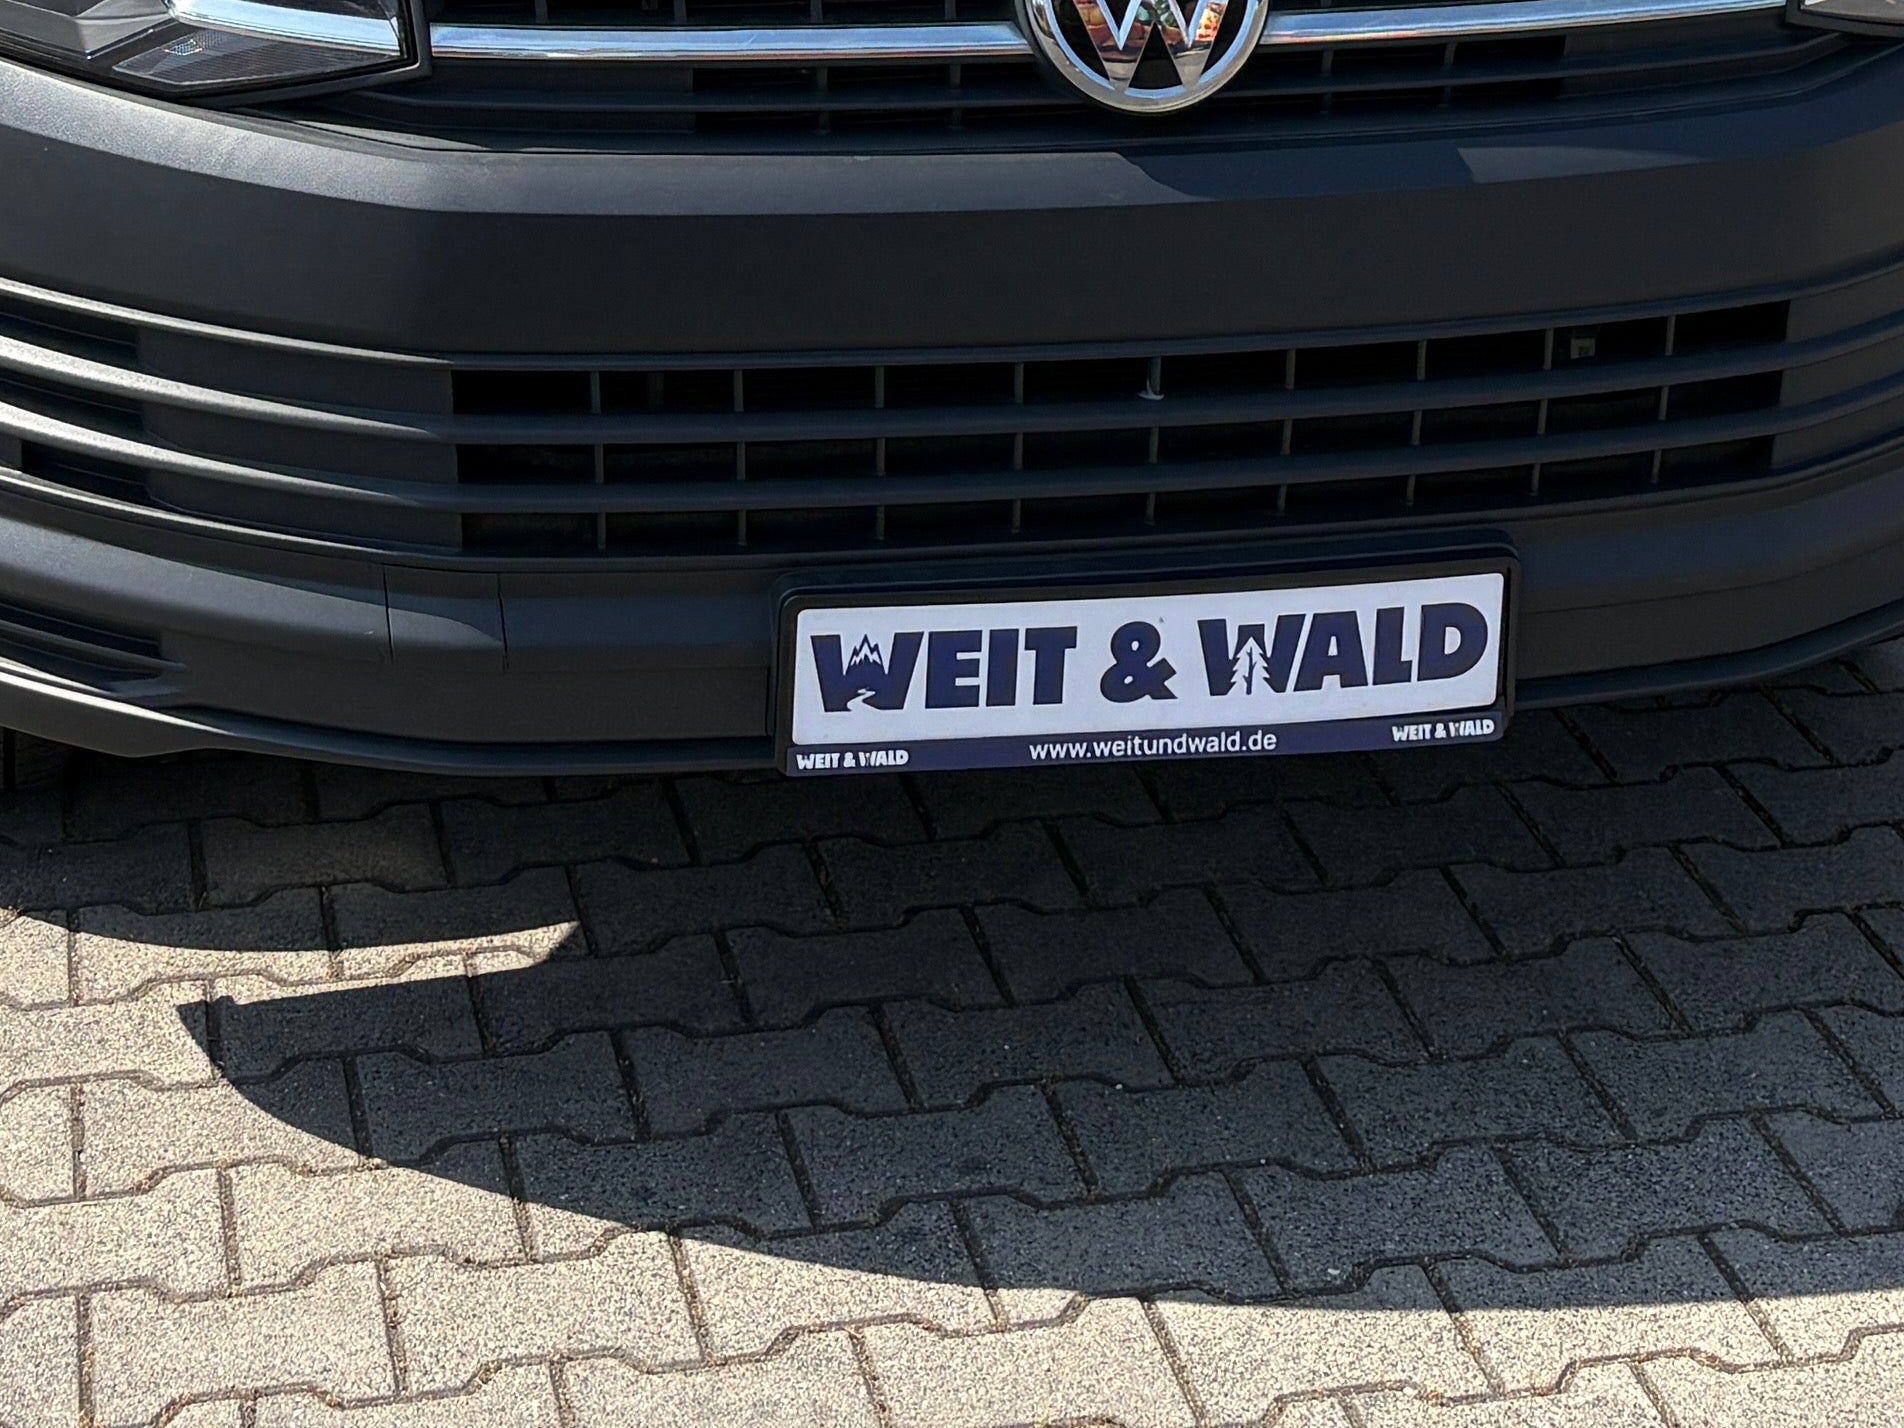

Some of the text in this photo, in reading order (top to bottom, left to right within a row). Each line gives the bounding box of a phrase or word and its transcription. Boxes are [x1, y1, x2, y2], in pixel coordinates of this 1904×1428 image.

[810, 602, 1490, 713] WEIT & WALD
[1029, 729, 1279, 761] www.weitundwald.de
[1391, 723, 1433, 742] WEIT
[1434, 722, 1447, 739] &
[795, 752, 841, 771] WEIT
[842, 751, 856, 768] &
